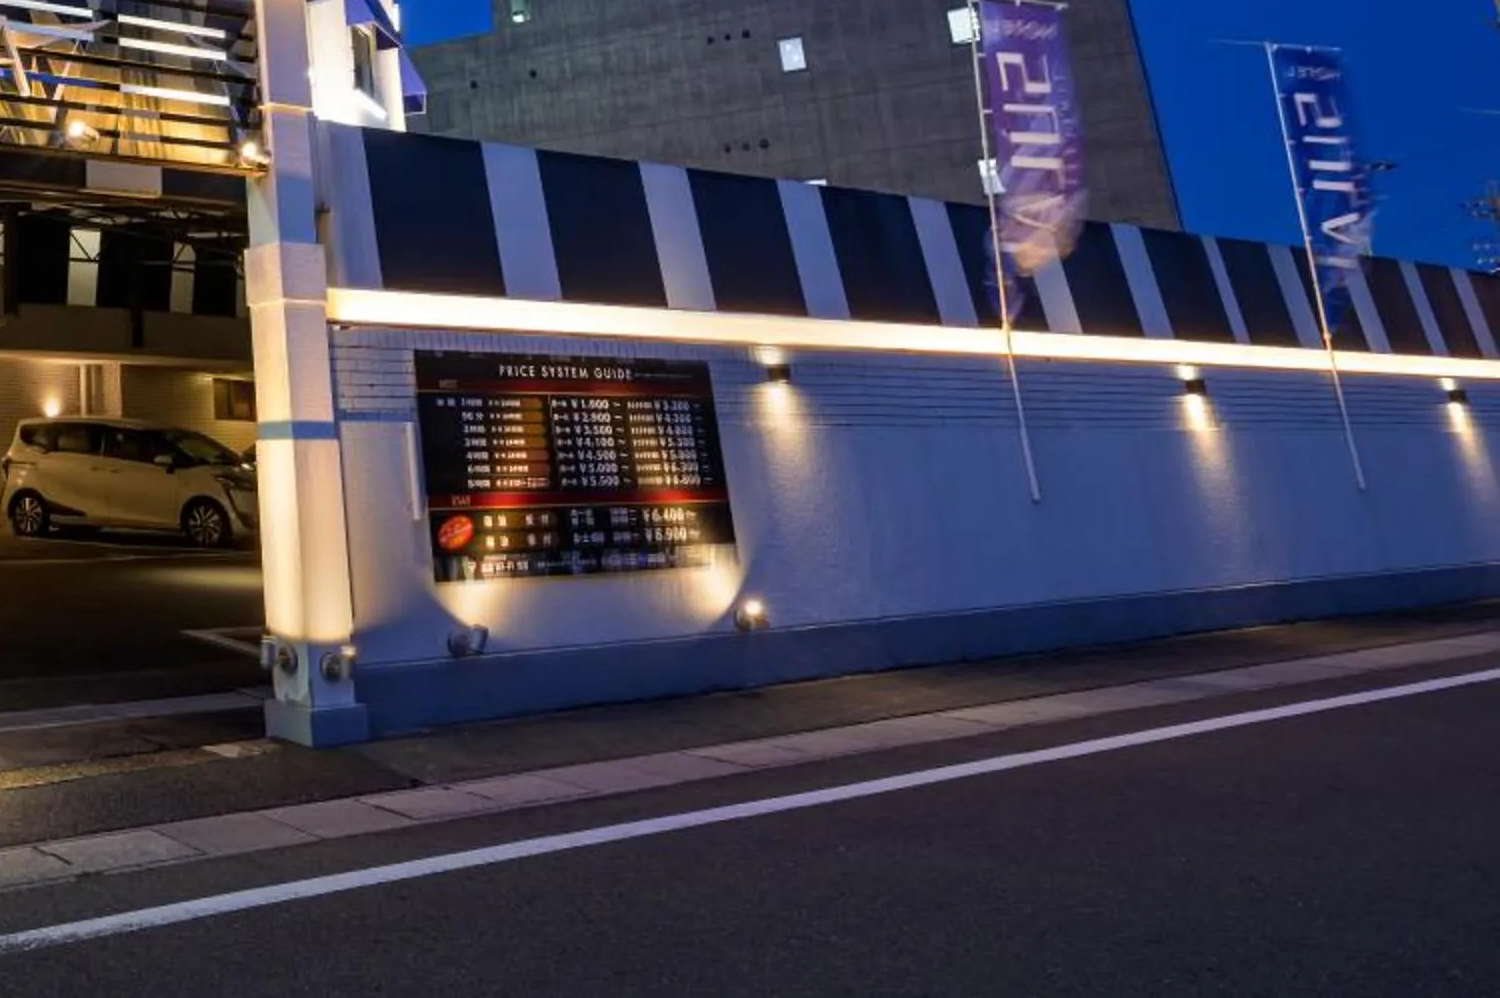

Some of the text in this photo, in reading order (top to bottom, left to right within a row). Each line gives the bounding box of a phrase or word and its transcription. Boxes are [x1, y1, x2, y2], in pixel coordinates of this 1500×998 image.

[500, 364, 633, 380] PRICE SYSTEM GUIDE
